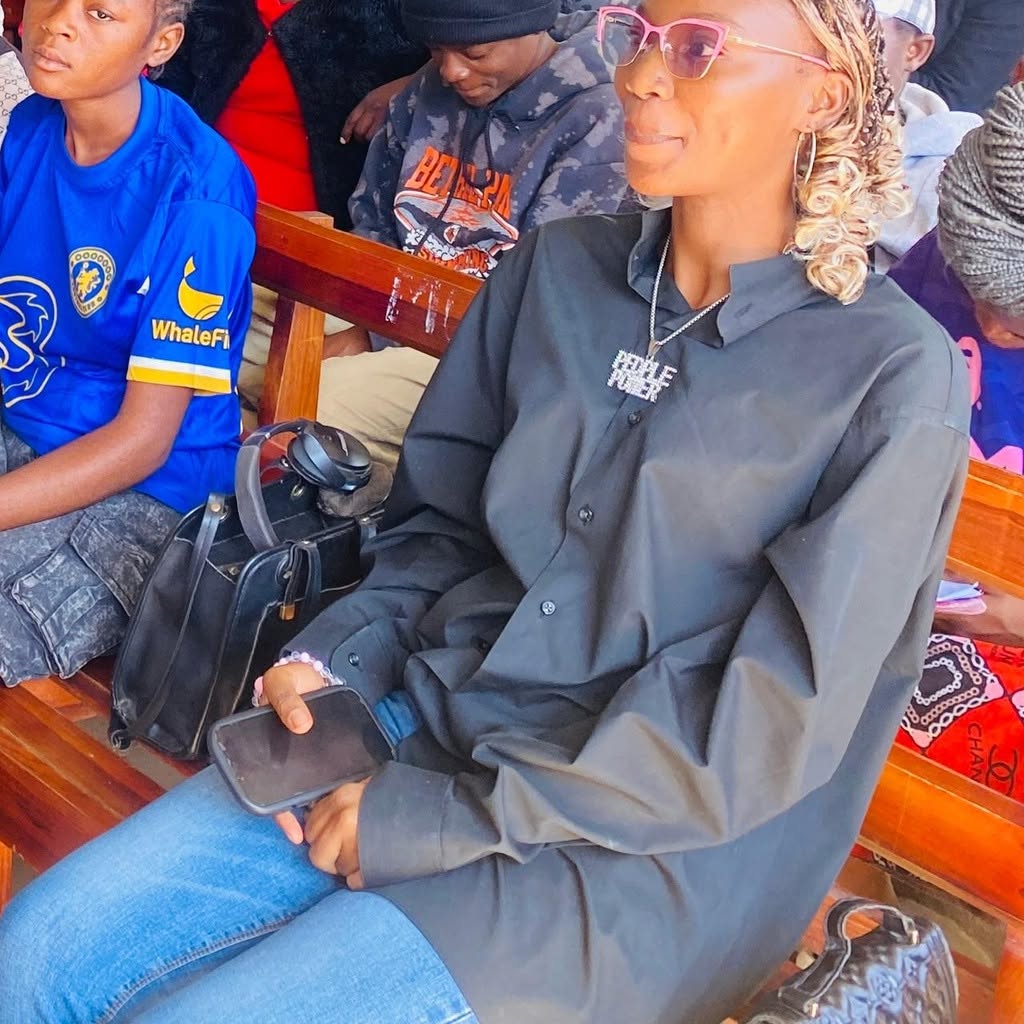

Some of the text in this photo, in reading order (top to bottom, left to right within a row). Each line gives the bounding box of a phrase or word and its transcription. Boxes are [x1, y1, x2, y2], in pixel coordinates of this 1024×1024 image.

[152, 319, 230, 349] WhaleFi
[612, 350, 678, 387] PEOPLE
[968, 723, 984, 783] CHAN
